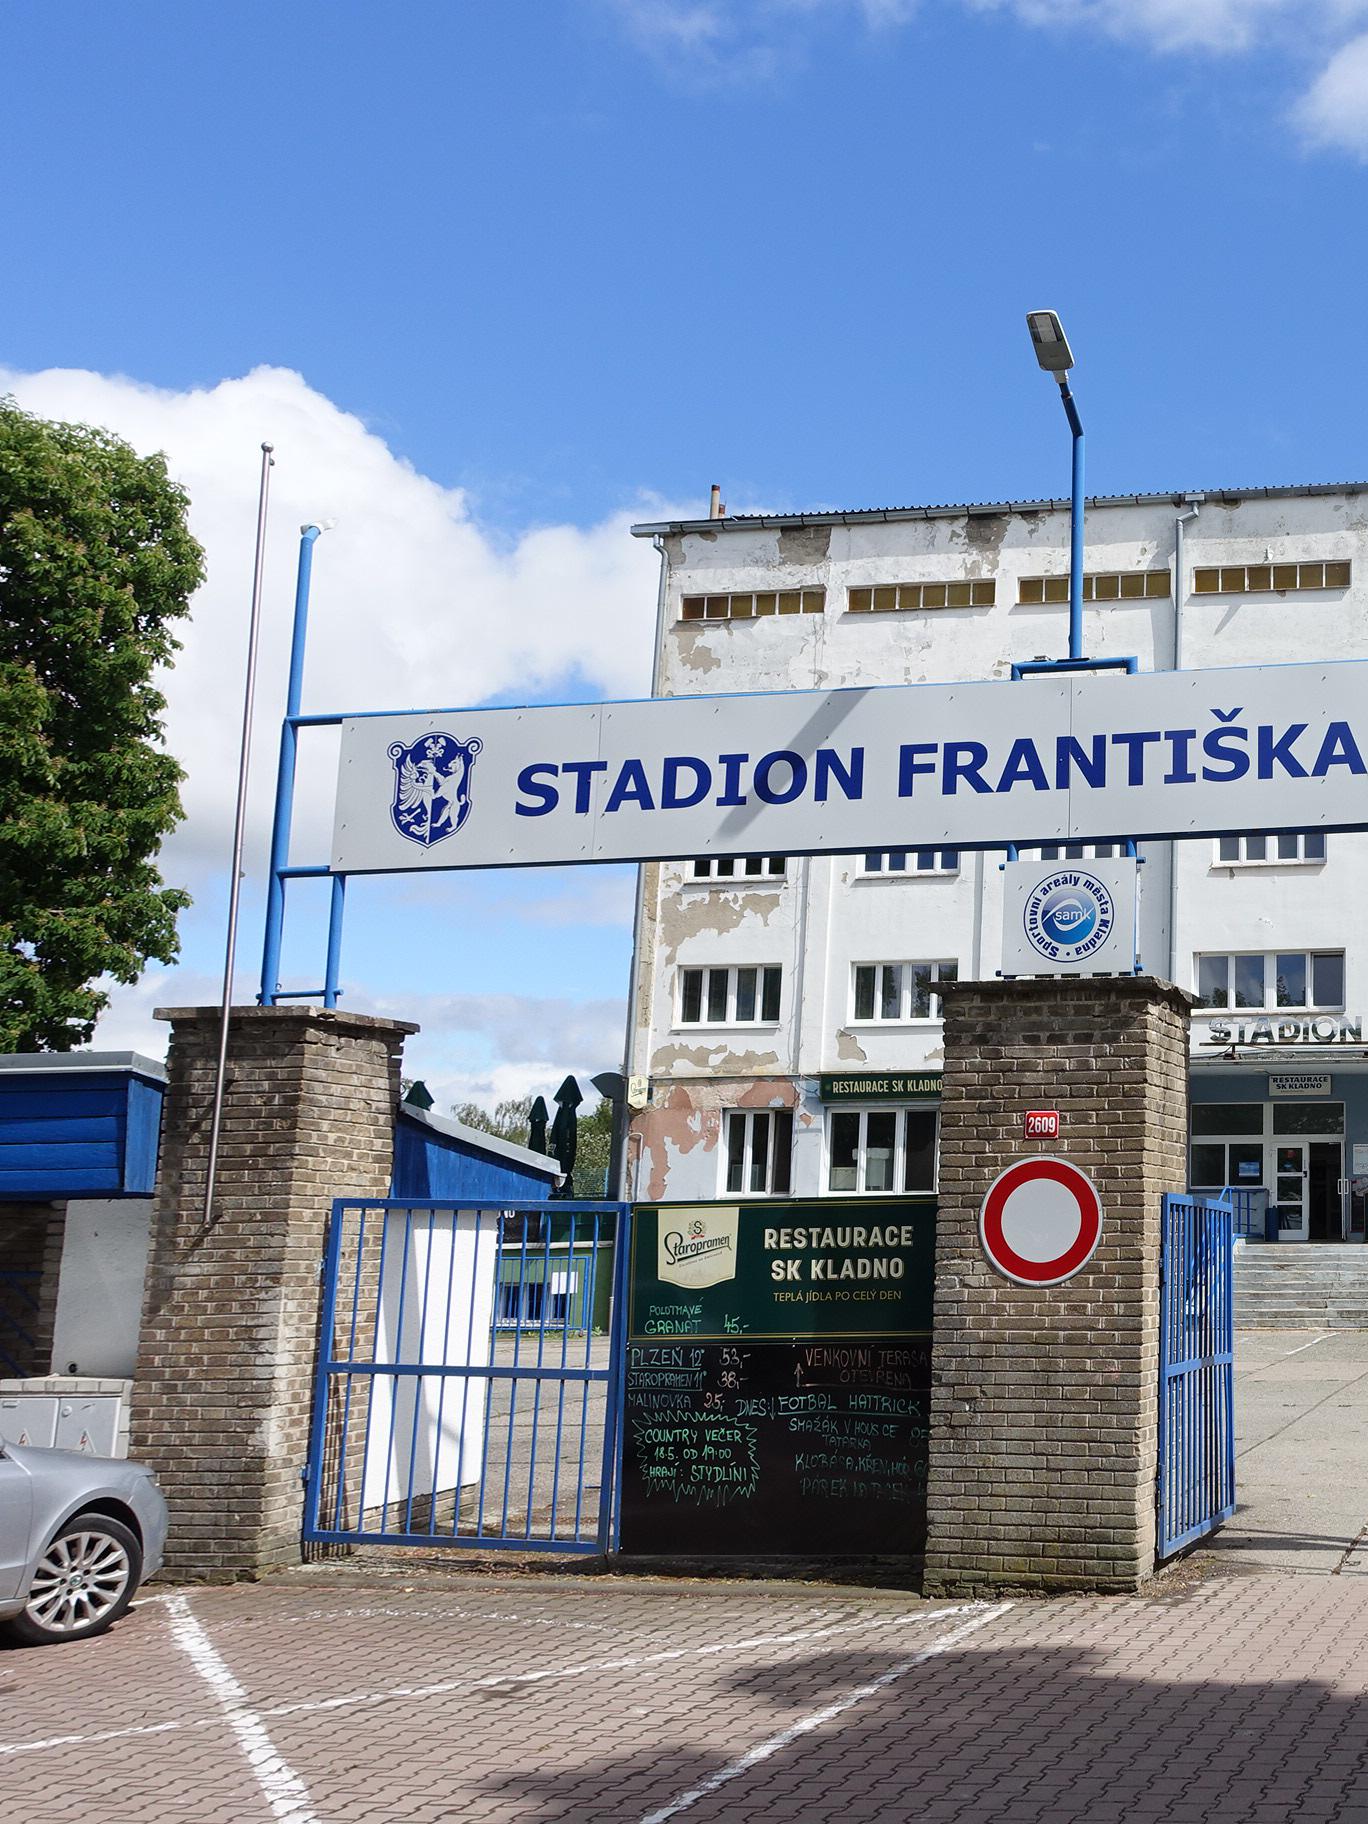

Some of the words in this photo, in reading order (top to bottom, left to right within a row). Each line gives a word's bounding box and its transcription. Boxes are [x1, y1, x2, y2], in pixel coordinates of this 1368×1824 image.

[515, 747, 864, 817] STADION
[898, 707, 1367, 797] FRANTIŠKA
[1040, 874, 1080, 896] areály
[1083, 880, 1109, 914] města
[1055, 908, 1094, 921] samk
[1075, 918, 1110, 956] Kladna
[1209, 1015, 1363, 1043] STADION
[832, 1080, 889, 1094] RESTAURACE
[891, 1080, 904, 1092] SK
[907, 1079, 943, 1092] KLADNO
[1271, 1076, 1329, 1084] RESTAURACE
[1028, 1116, 1056, 1133] 2609
[764, 1226, 914, 1249] RESTAURACE
[664, 1231, 731, 1265] Staropramen
[771, 1259, 802, 1281] SK
[811, 1257, 905, 1280] KLADNO
[773, 1290, 803, 1302] TEPLÁ
[805, 1290, 832, 1303] JÍDLA
[836, 1291, 850, 1301] PO
[853, 1288, 877, 1300] CELÝ
[879, 1290, 901, 1300] DEN
[631, 1347, 683, 1366] PLZEŇ
[878, 1350, 928, 1367] TERASA
[627, 1372, 692, 1387] STAROPRAMEN
[778, 1394, 838, 1411] FOTBAL
[849, 1395, 920, 1416] HATTRICK
[789, 1415, 839, 1434] SMAŽÁK
[644, 1429, 698, 1445] COUNTRY
[705, 1428, 742, 1443] VEČER
[683, 1449, 698, 1460] OD
[702, 1445, 732, 1461] 19:00
[690, 1461, 747, 1482] STYDLÍNI
